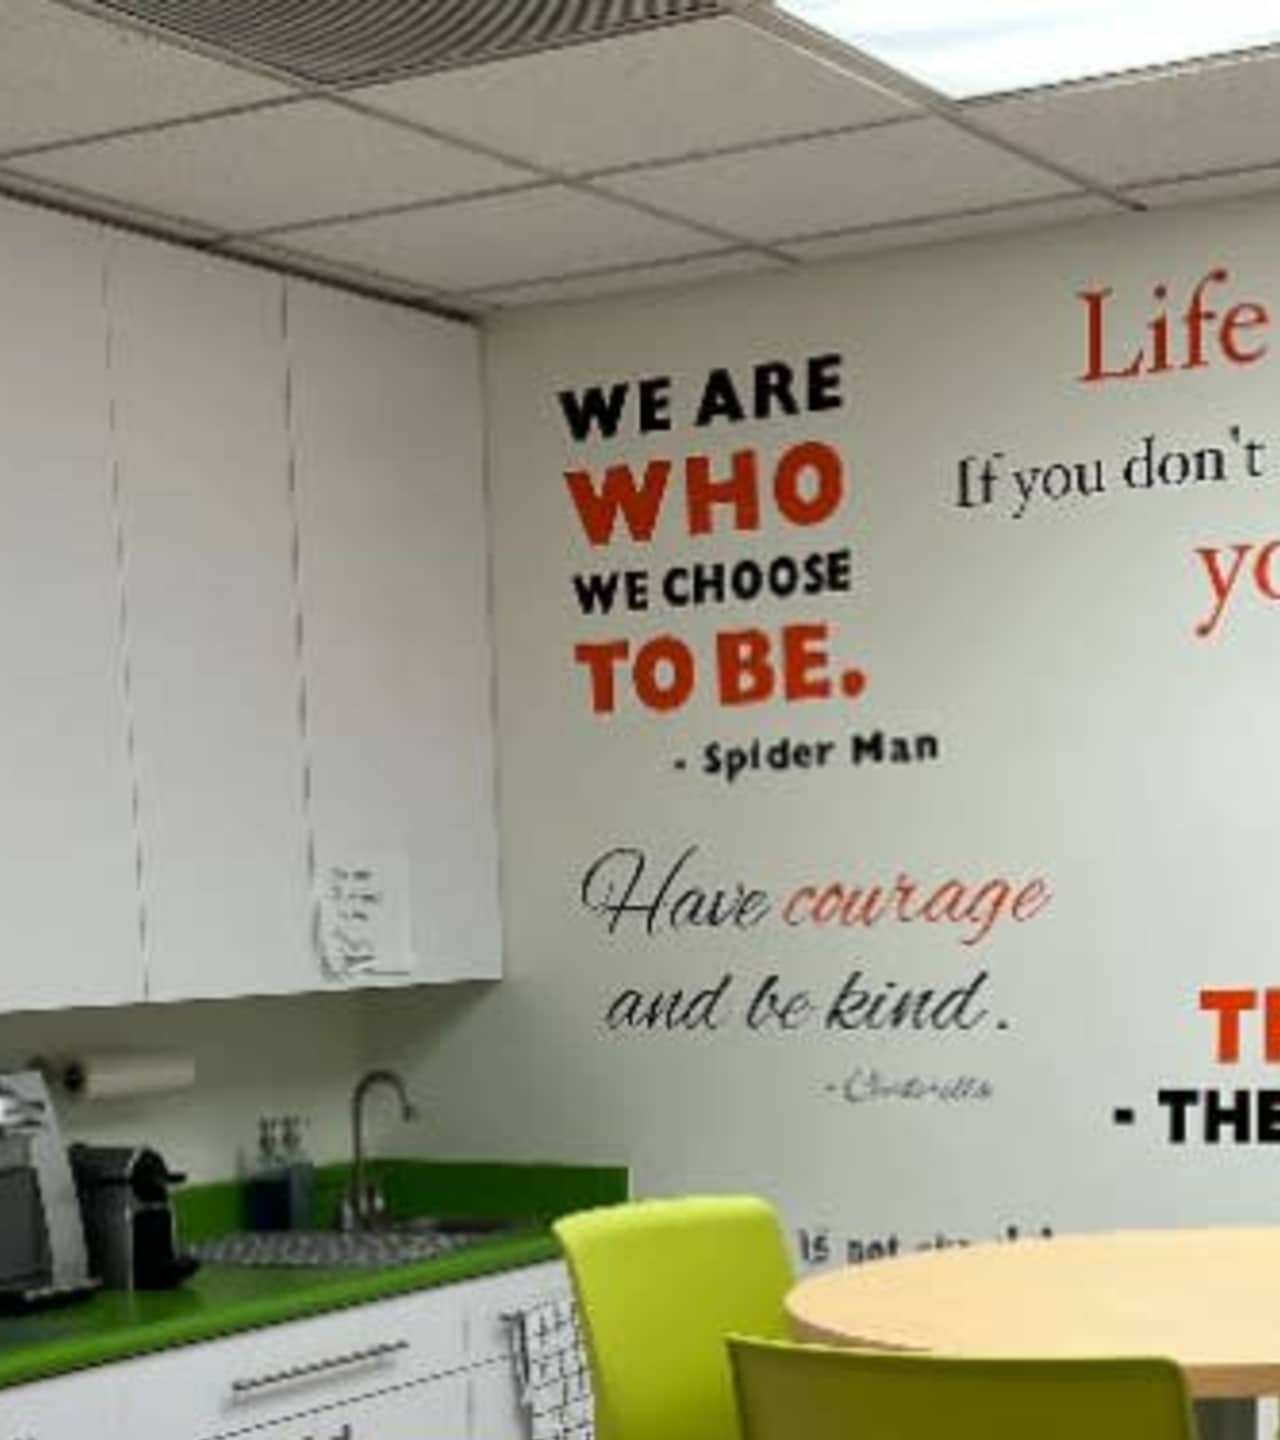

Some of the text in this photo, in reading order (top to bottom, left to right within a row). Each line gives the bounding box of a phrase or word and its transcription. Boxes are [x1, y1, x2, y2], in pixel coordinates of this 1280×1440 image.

[1075, 268, 1269, 384] Life
[558, 354, 845, 442] WE ARE
[563, 440, 845, 548] WHO
[954, 452, 1002, 508] If
[1010, 454, 1103, 518] you
[1123, 424, 1266, 490] don't
[573, 548, 851, 614] WE CHOOSE
[574, 622, 866, 715] TO BE.
[702, 736, 835, 782] Spider
[851, 732, 940, 766] Man
[580, 843, 1052, 945] Have courage
[605, 970, 1010, 1030] and be kind.
